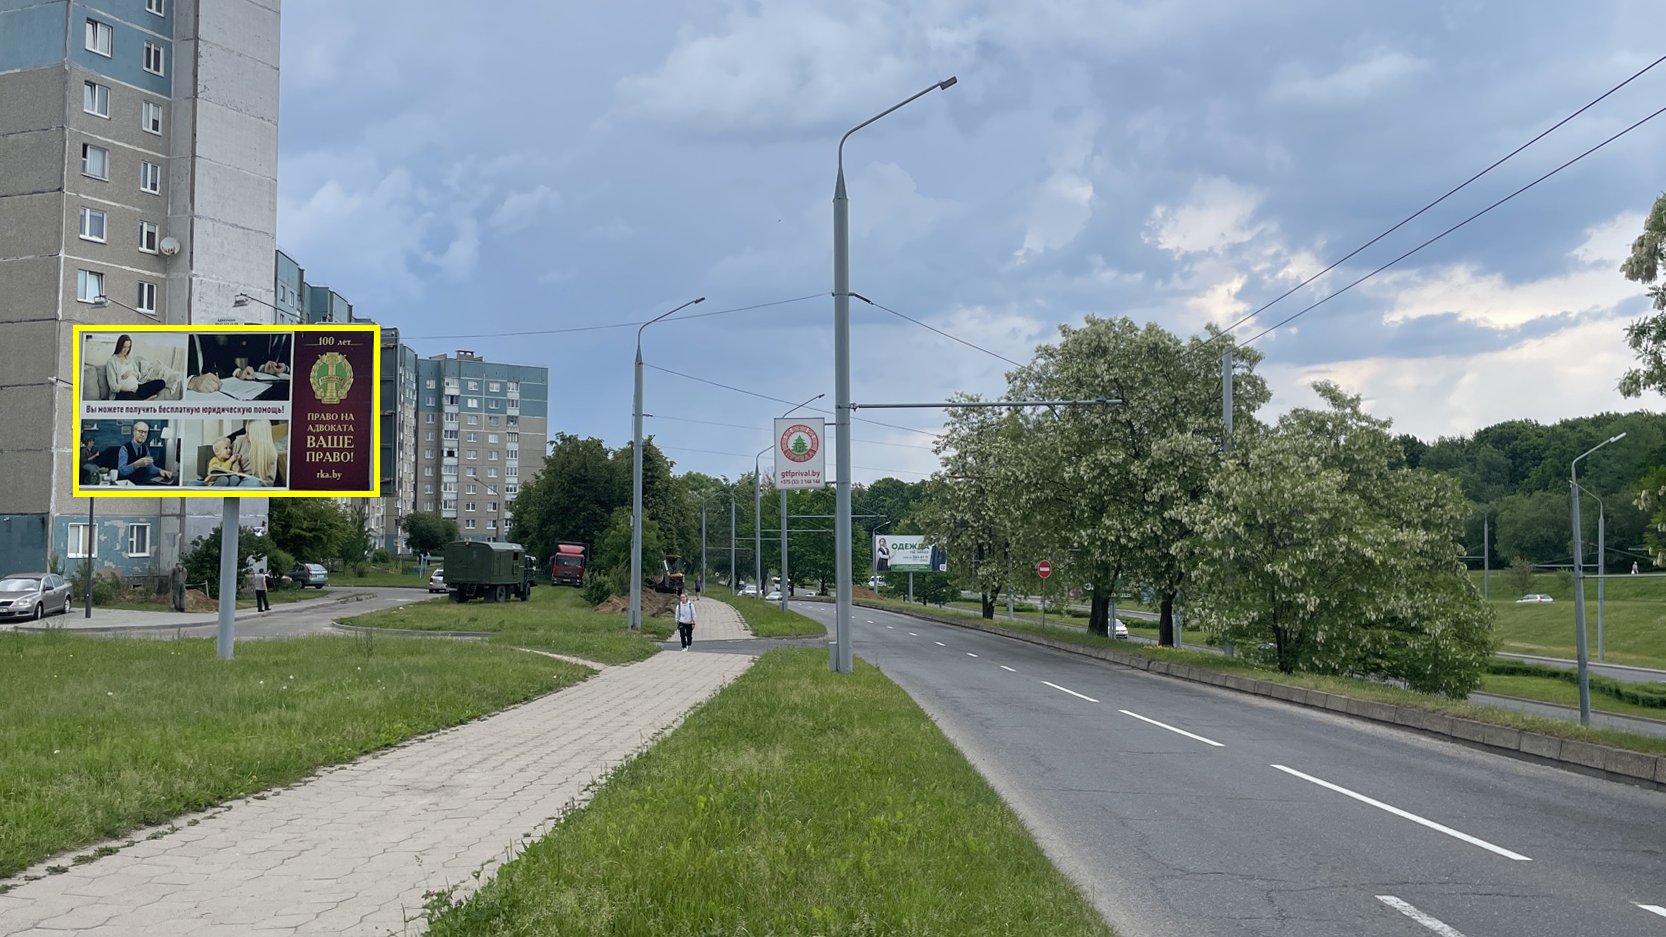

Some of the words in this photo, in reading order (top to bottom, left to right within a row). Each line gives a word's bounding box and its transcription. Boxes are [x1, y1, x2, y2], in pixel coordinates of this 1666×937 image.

[319, 337, 334, 346] 100
[86, 405, 97, 413] Вы
[125, 407, 157, 415] получить
[158, 405, 200, 415] бесплатную
[202, 406, 252, 415] юридическую
[253, 405, 285, 415] помощь!
[307, 413, 338, 421] ПРАВО
[341, 413, 355, 421] НА
[307, 424, 355, 433] АДВОКАТА
[306, 435, 355, 448] ВАШЕ
[306, 452, 354, 463] ПРАВО!
[316, 469, 342, 480] rka.by
[781, 470, 821, 478] gtfprival.by
